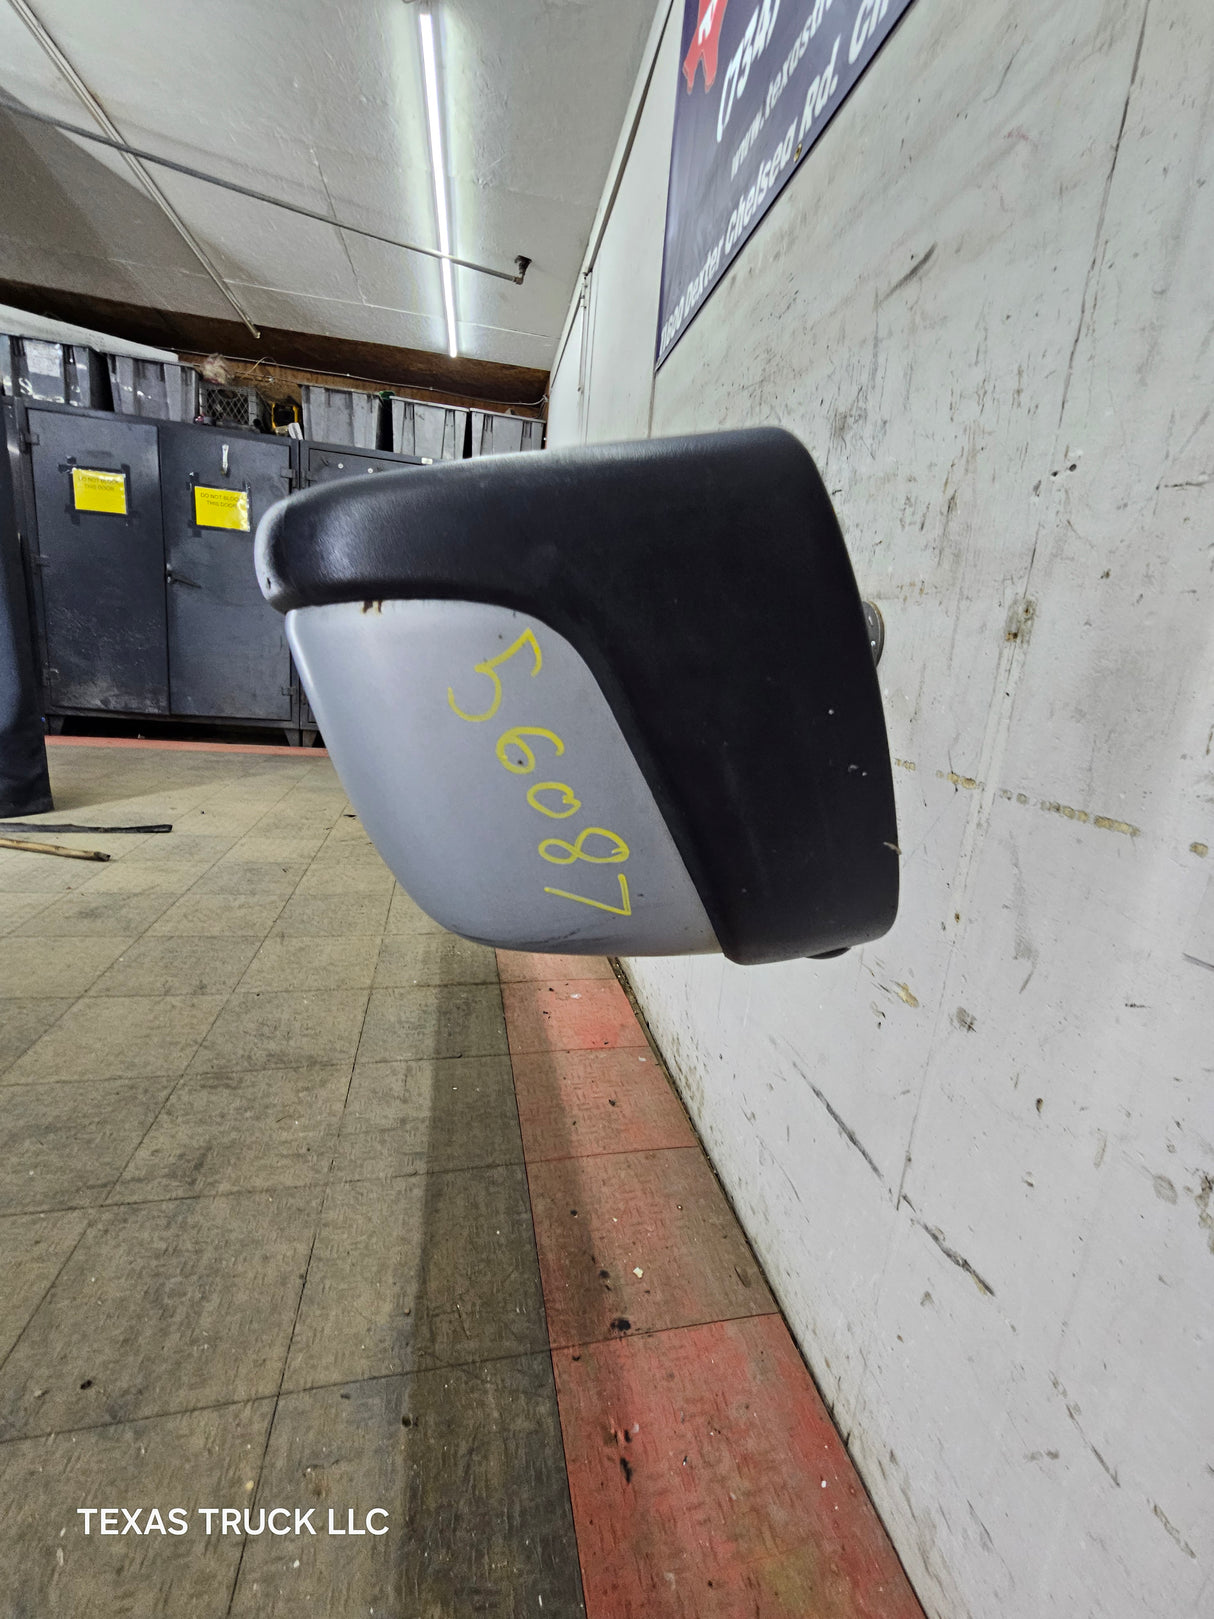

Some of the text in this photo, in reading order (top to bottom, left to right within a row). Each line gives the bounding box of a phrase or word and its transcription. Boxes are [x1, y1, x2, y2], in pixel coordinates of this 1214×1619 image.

[684, 235, 724, 319] Dexter
[724, 116, 798, 255] Chelsea
[798, 33, 842, 142] Rd.
[447, 627, 632, 917] 56087
